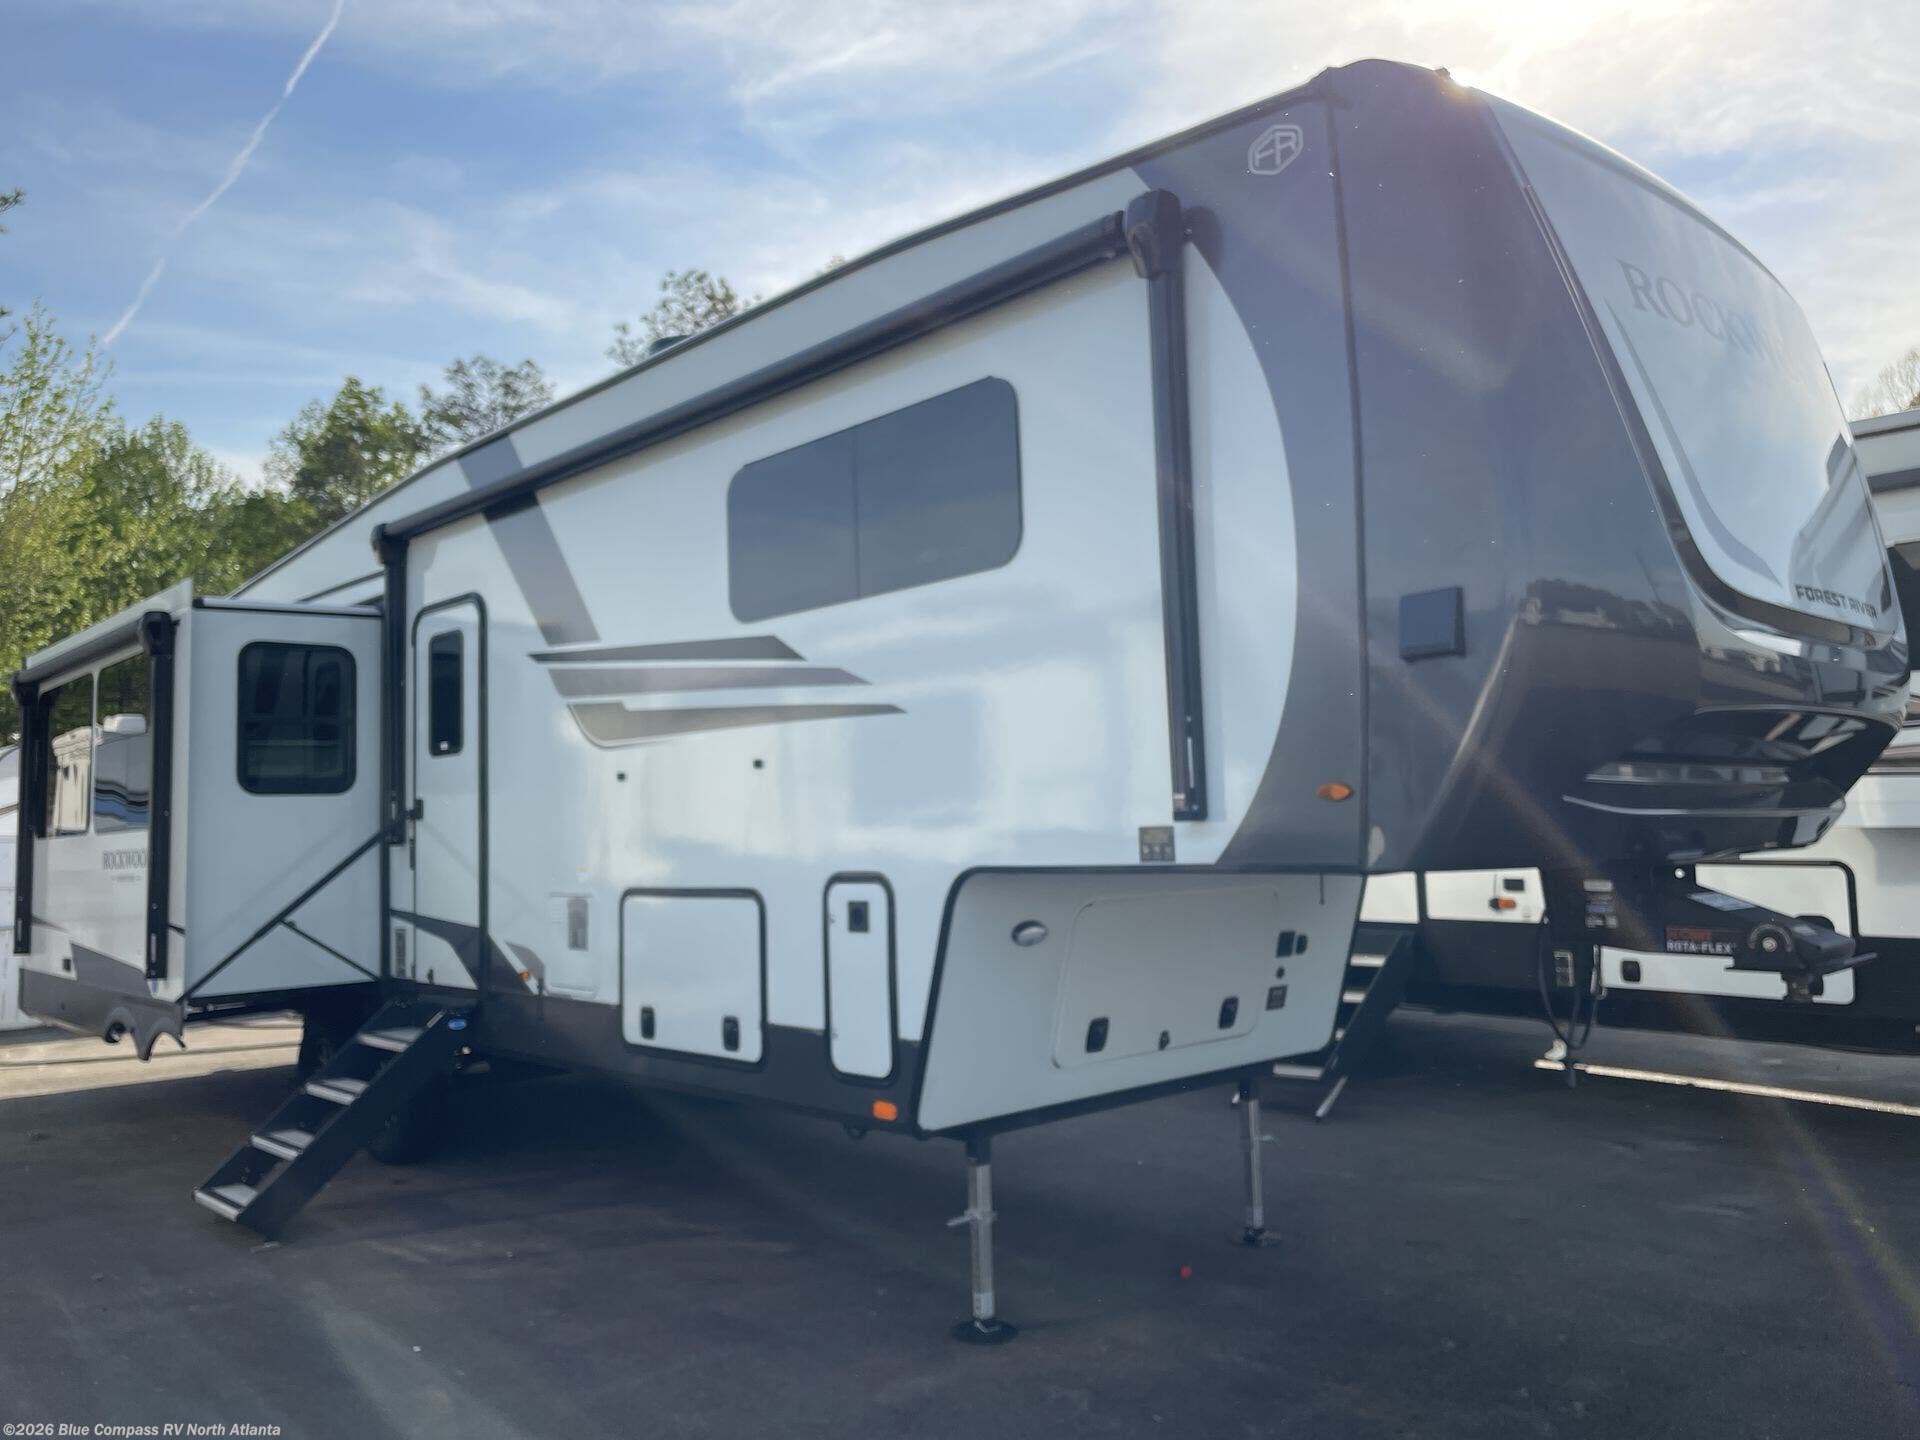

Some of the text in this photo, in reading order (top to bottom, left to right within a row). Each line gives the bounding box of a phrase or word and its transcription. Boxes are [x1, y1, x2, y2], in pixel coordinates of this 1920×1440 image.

[1795, 585, 1878, 619] FOREST RIVER
[102, 849, 147, 870] ROCKWOO
